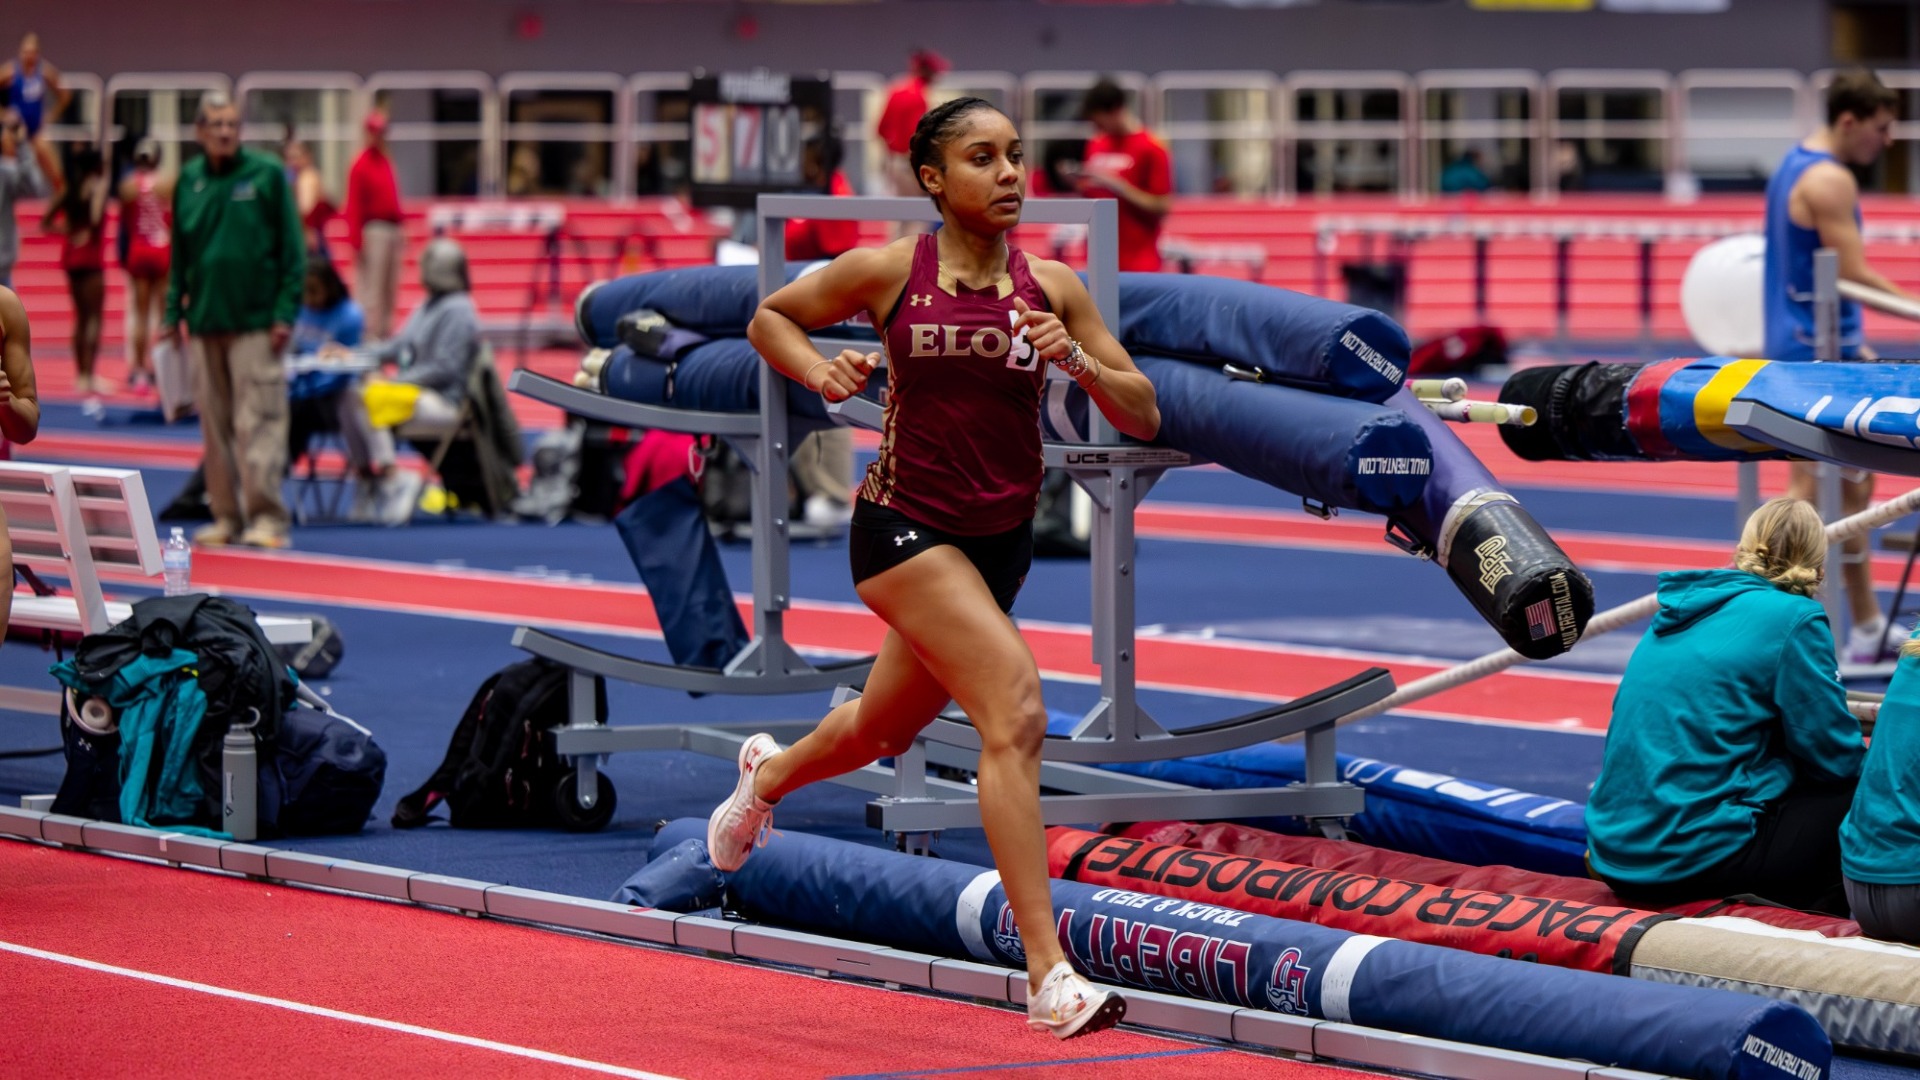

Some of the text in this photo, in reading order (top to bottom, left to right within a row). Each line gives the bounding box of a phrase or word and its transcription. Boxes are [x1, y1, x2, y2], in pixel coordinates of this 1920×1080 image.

[909, 324, 1013, 358] ELO
[1339, 330, 1404, 385] VAULTRENTAL.COM
[1066, 453, 1110, 464] UCS
[1358, 457, 1430, 475] VAULTRENTAL.COM
[1087, 839, 1638, 944] PACER COMPOSITE
[1091, 889, 1254, 928] TRACK & FIELD
